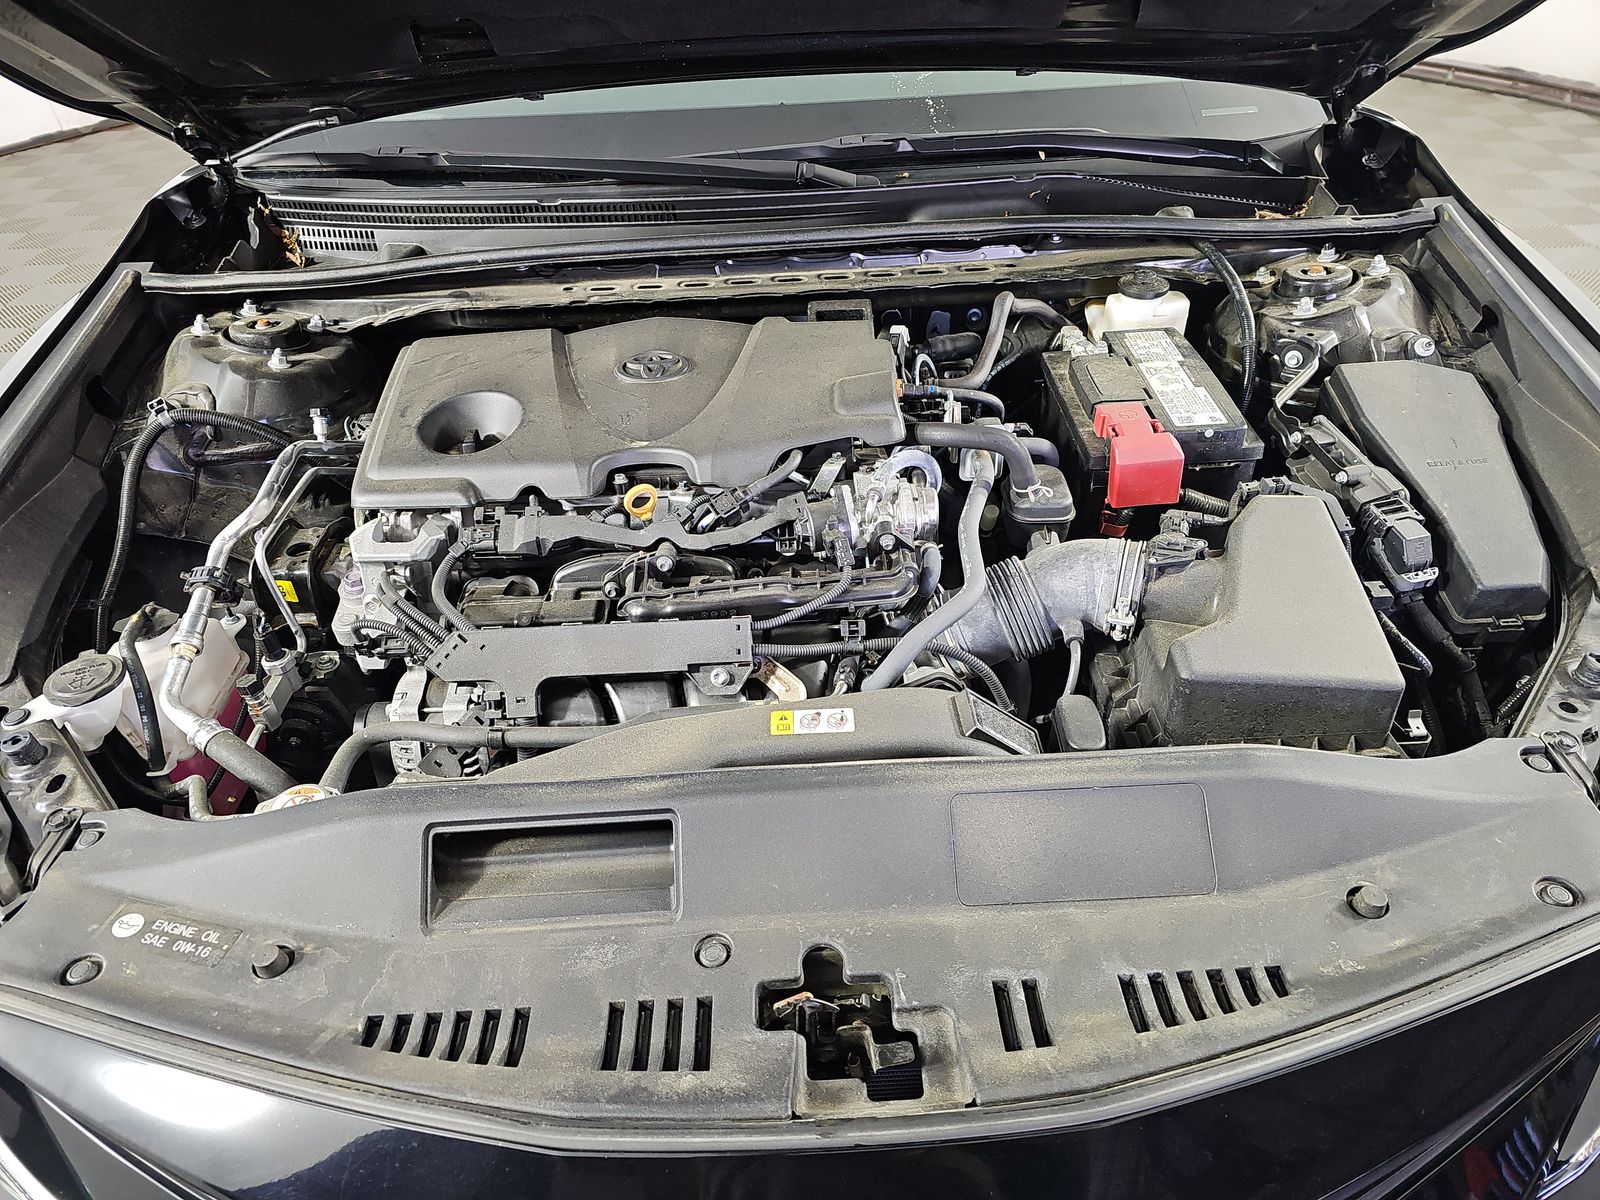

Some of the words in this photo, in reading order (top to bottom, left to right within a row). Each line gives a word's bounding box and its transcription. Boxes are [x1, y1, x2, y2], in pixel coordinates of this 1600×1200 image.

[152, 919, 198, 938] ENGINE
[201, 930, 220, 944] OIL
[141, 933, 169, 948] SAE
[172, 940, 212, 958] 0W-16
